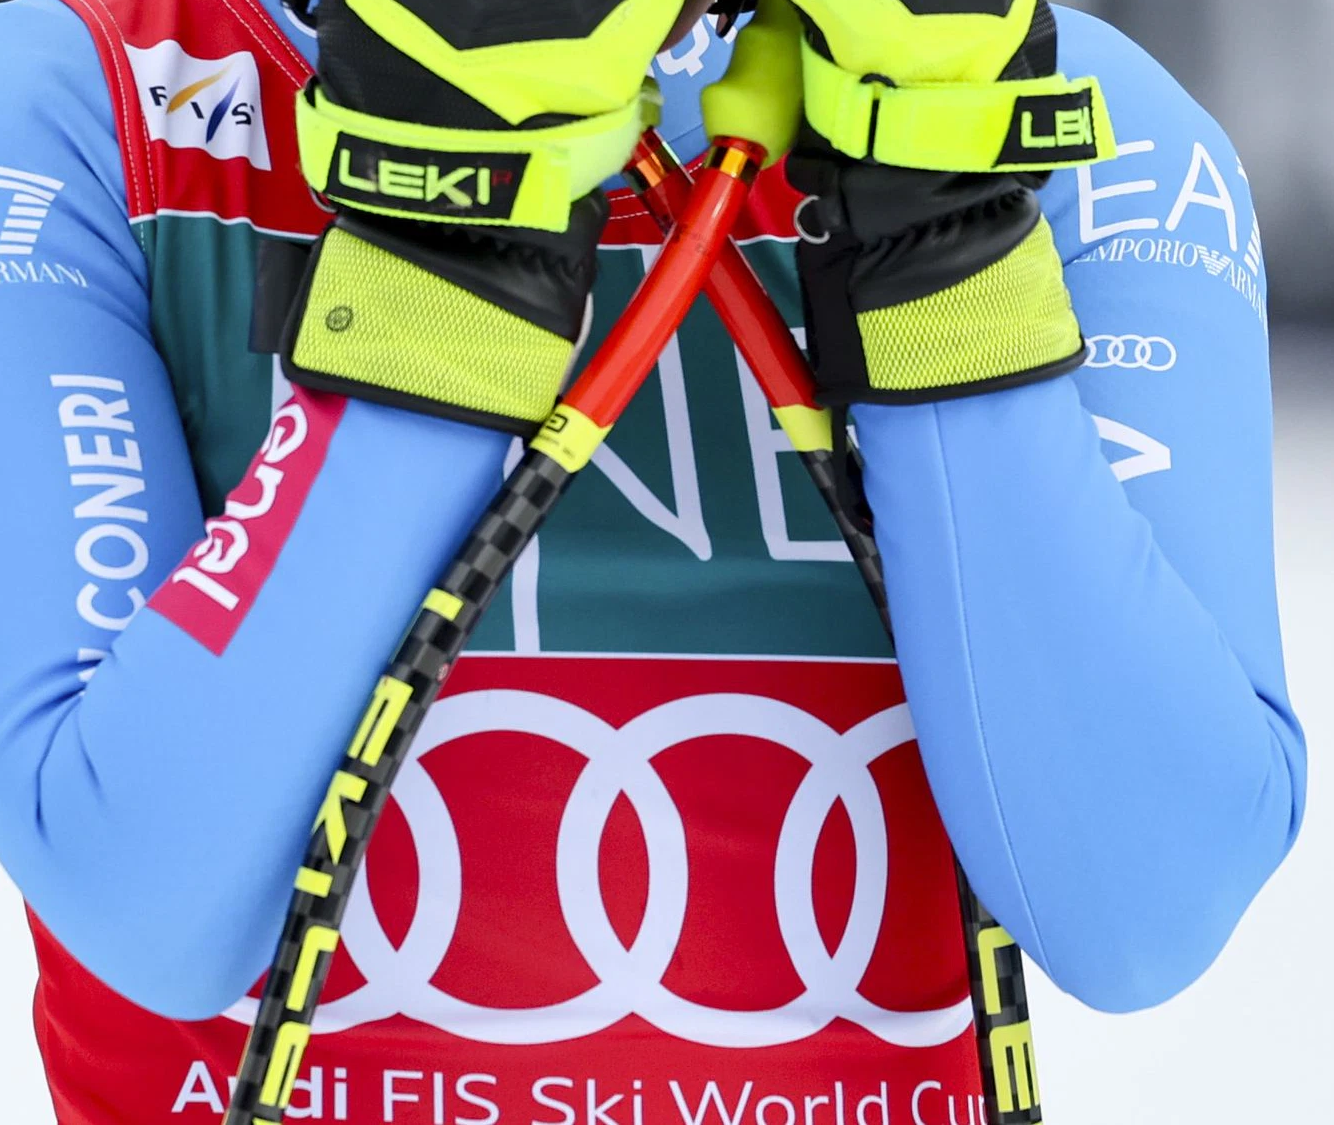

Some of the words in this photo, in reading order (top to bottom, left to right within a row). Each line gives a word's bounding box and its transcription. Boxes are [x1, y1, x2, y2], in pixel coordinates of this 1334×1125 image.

[149, 85, 255, 125] FIS
[338, 148, 490, 206] LEKI
[51, 374, 149, 683] CONERI
[172, 404, 308, 611] enel
[171, 1060, 349, 1120] Adi
[382, 1069, 500, 1125] FIS
[531, 1076, 643, 1125] Ski
[668, 1079, 889, 1125] World
